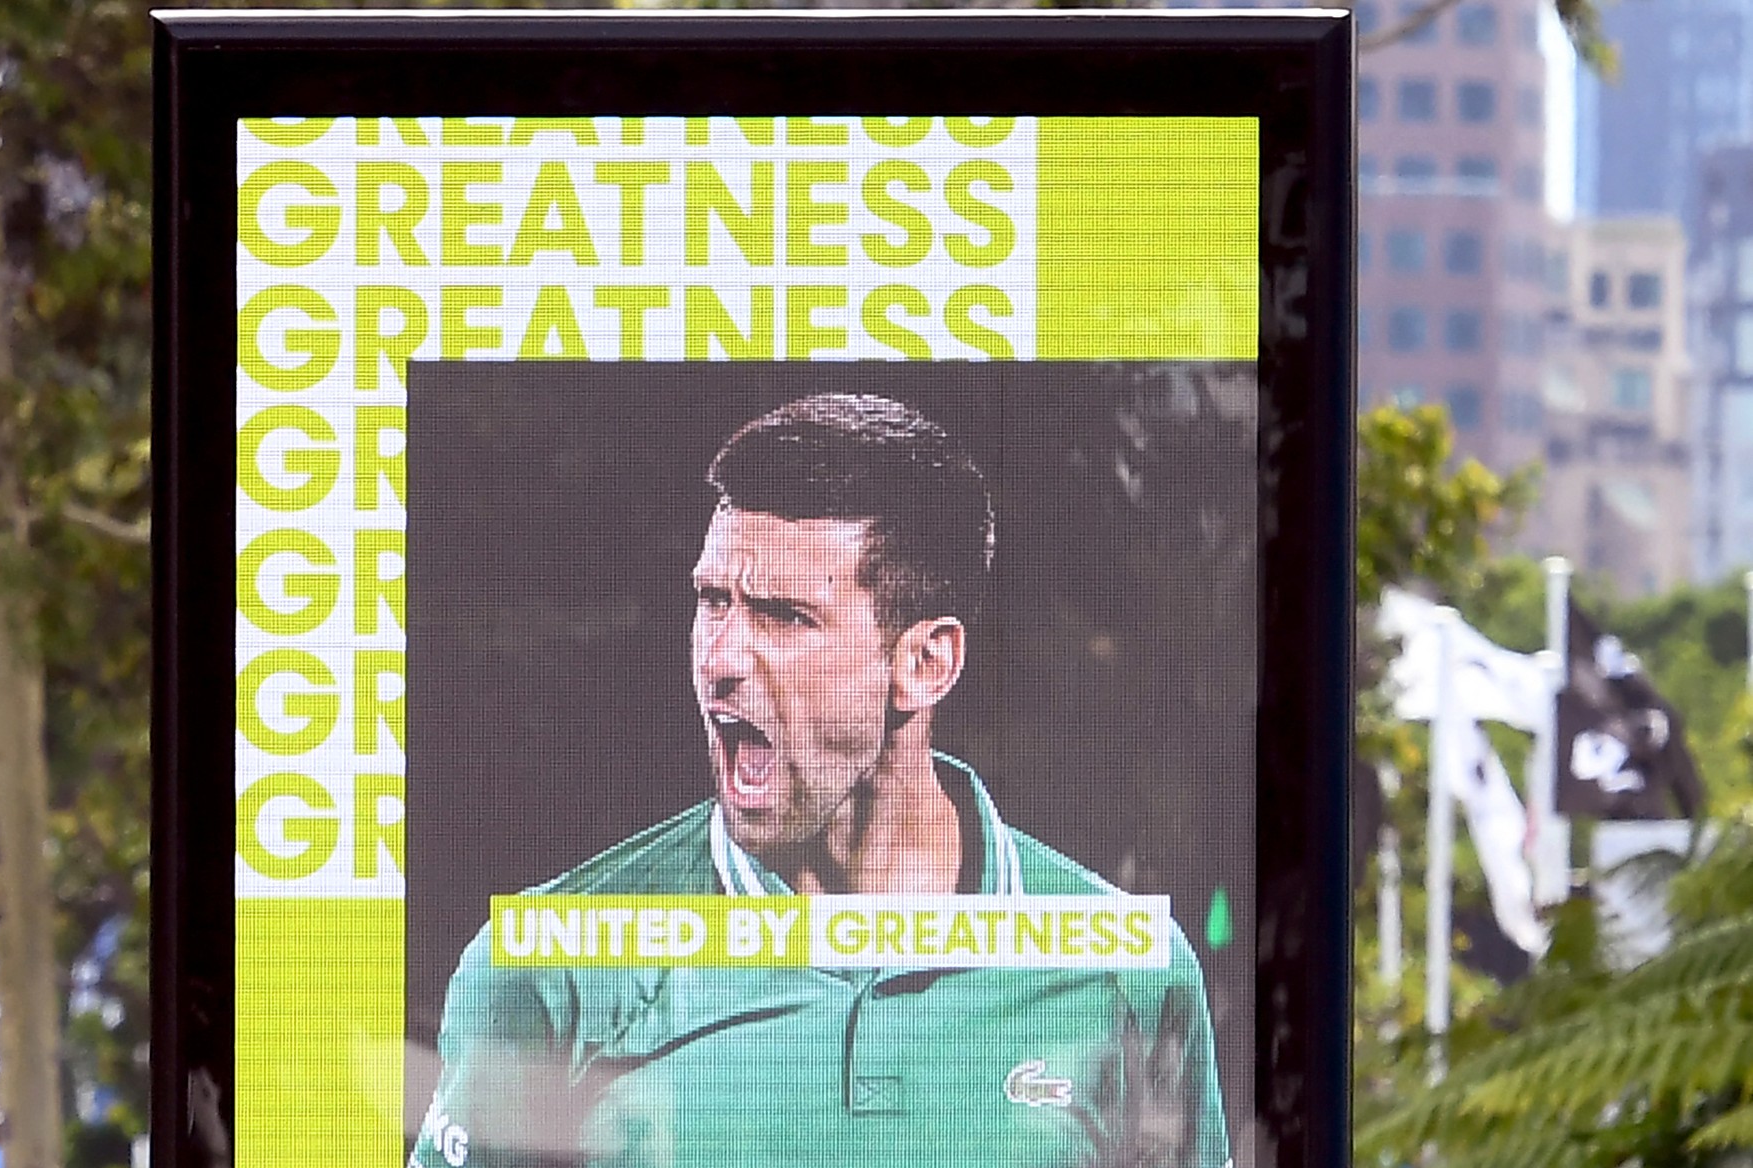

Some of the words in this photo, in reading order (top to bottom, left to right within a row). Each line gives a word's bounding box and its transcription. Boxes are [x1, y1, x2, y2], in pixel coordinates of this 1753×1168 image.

[237, 159, 1016, 267] GREATNESS
[501, 908, 707, 957] UNITED
[725, 908, 800, 957] BY
[826, 909, 1154, 957] GREATNESS
